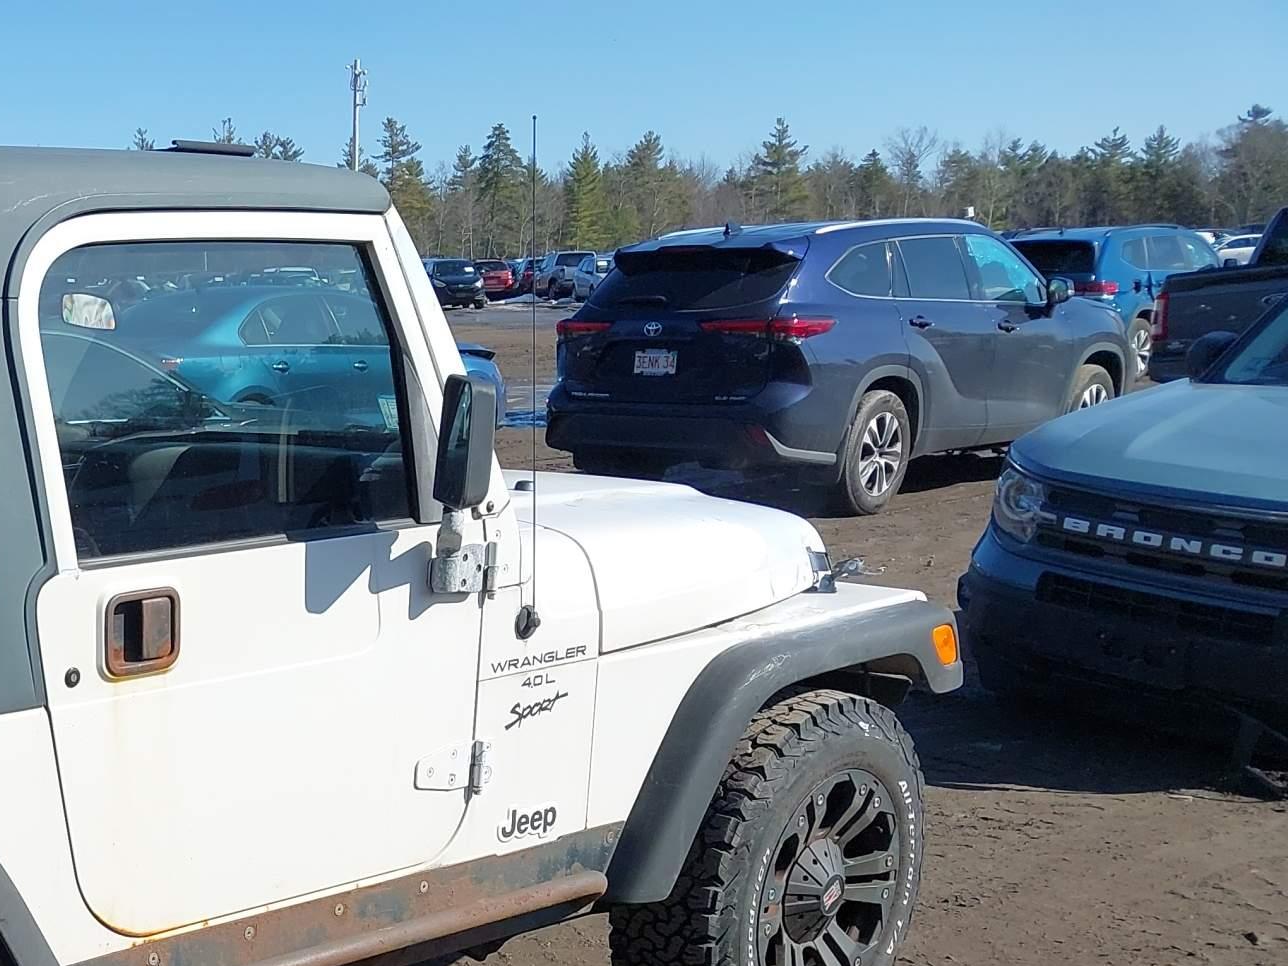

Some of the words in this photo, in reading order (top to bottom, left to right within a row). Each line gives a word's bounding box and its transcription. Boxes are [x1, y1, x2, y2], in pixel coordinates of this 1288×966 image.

[1063, 516, 1288, 568] BRONCO
[490, 645, 587, 674] WRANGLER
[501, 805, 557, 838] Jeep
[897, 780, 916, 905] All-Terrain
